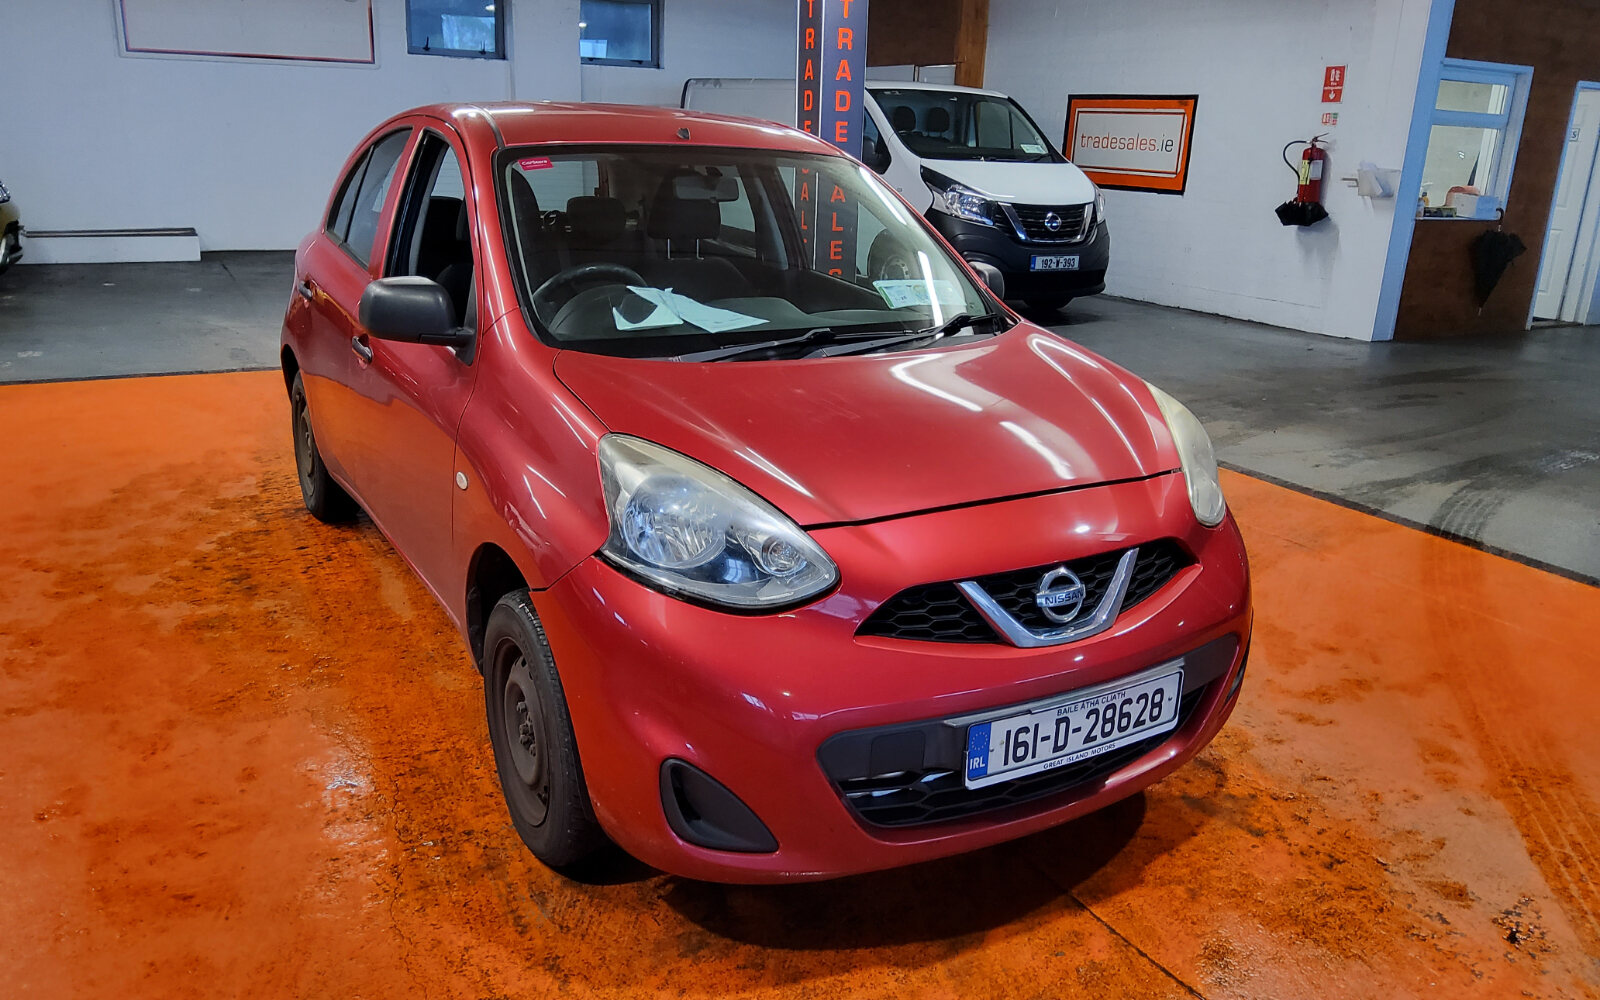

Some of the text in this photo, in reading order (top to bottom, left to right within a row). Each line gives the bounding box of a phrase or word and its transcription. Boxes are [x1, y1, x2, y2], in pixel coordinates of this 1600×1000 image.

[1080, 132, 1174, 152] tradesales.ie
[1044, 590, 1083, 605] NISSAN
[1057, 705, 1079, 716] BAILE
[1101, 691, 1126, 704] CLIATH
[1003, 687, 1165, 767] 161-D-28628
[969, 756, 986, 770] IRL
[1043, 743, 1116, 769] GREAT ISLAND MOTORS
